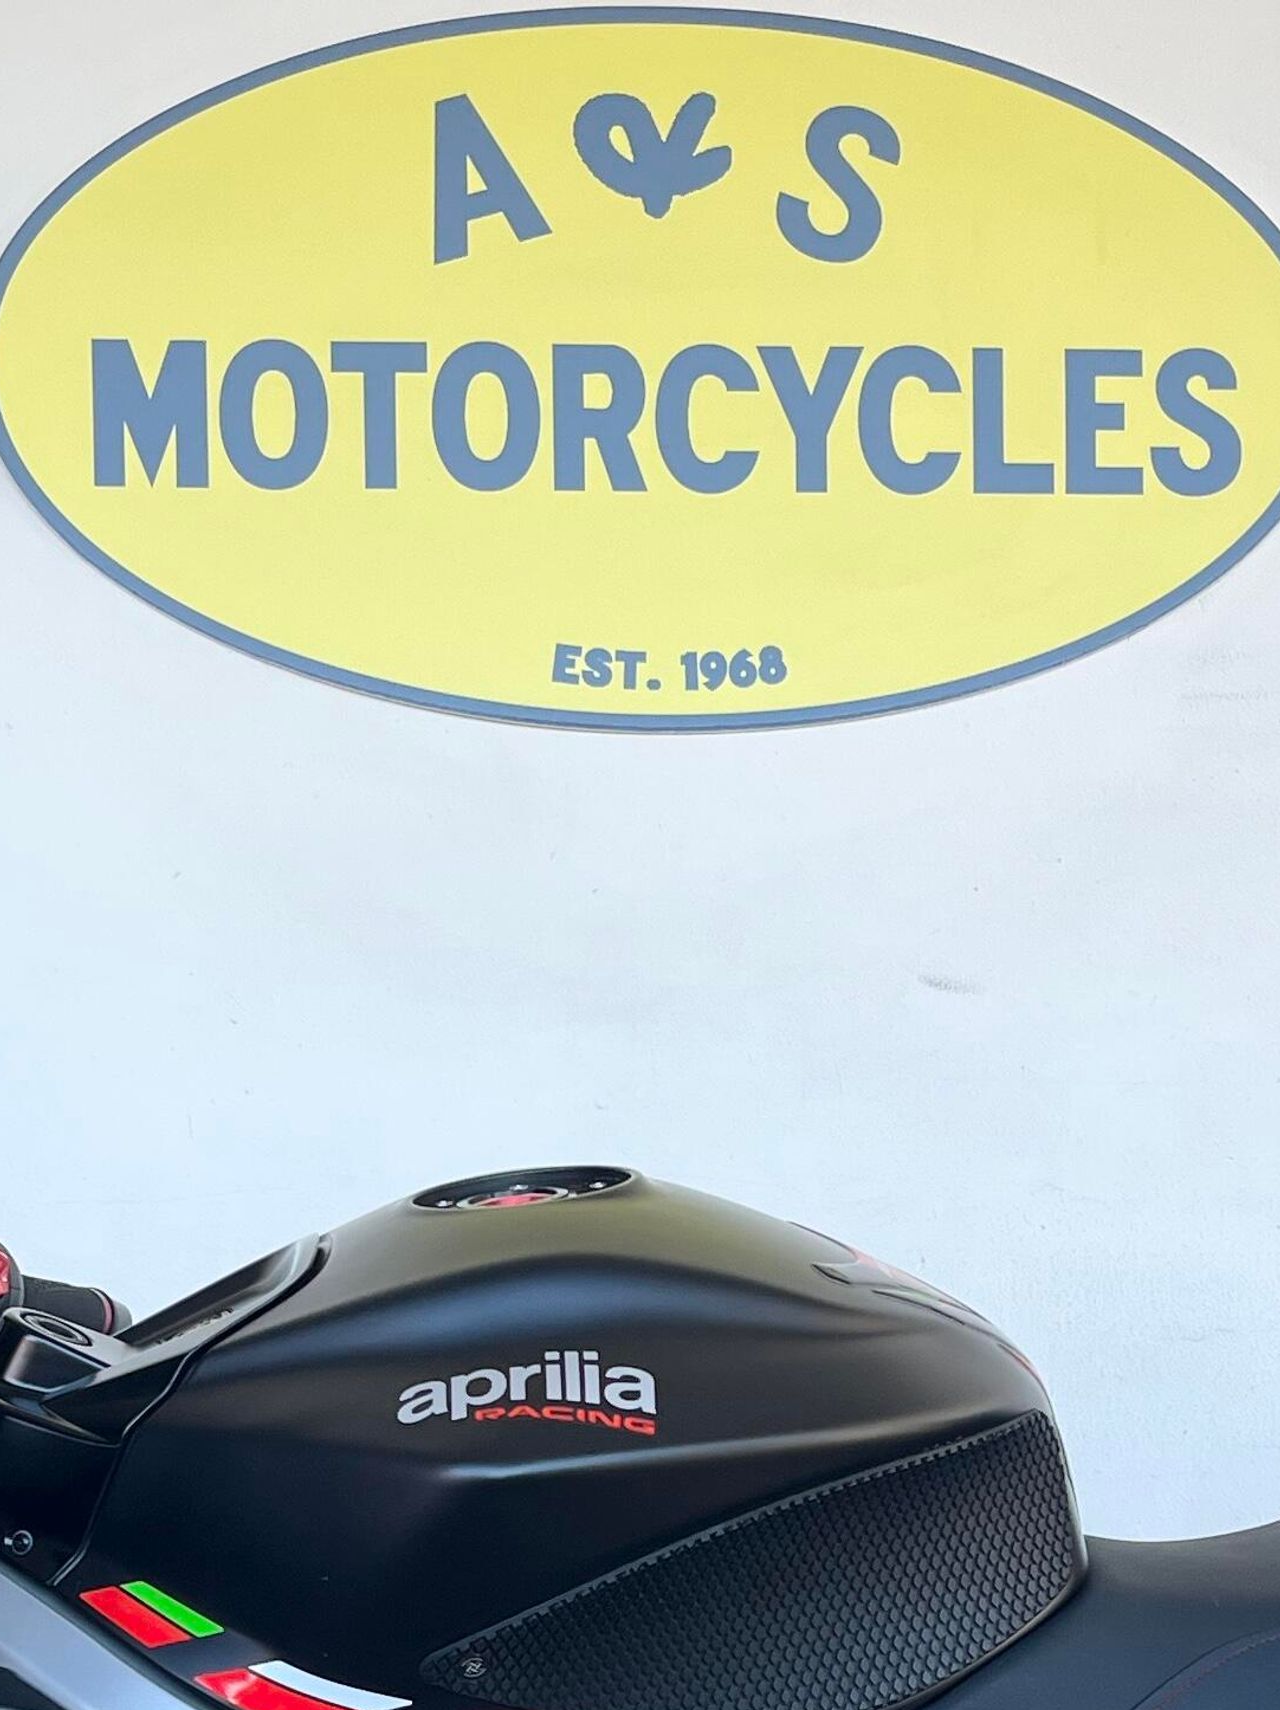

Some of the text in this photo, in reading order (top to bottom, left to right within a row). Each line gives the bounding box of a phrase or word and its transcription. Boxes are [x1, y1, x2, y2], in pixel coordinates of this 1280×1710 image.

[433, 93, 553, 265] A
[775, 105, 901, 264] S
[90, 337, 1243, 497] MOTORCYCLES
[551, 644, 788, 691] EST. 1968
[396, 1350, 658, 1425] aprilia
[472, 1404, 657, 1436] RACING
